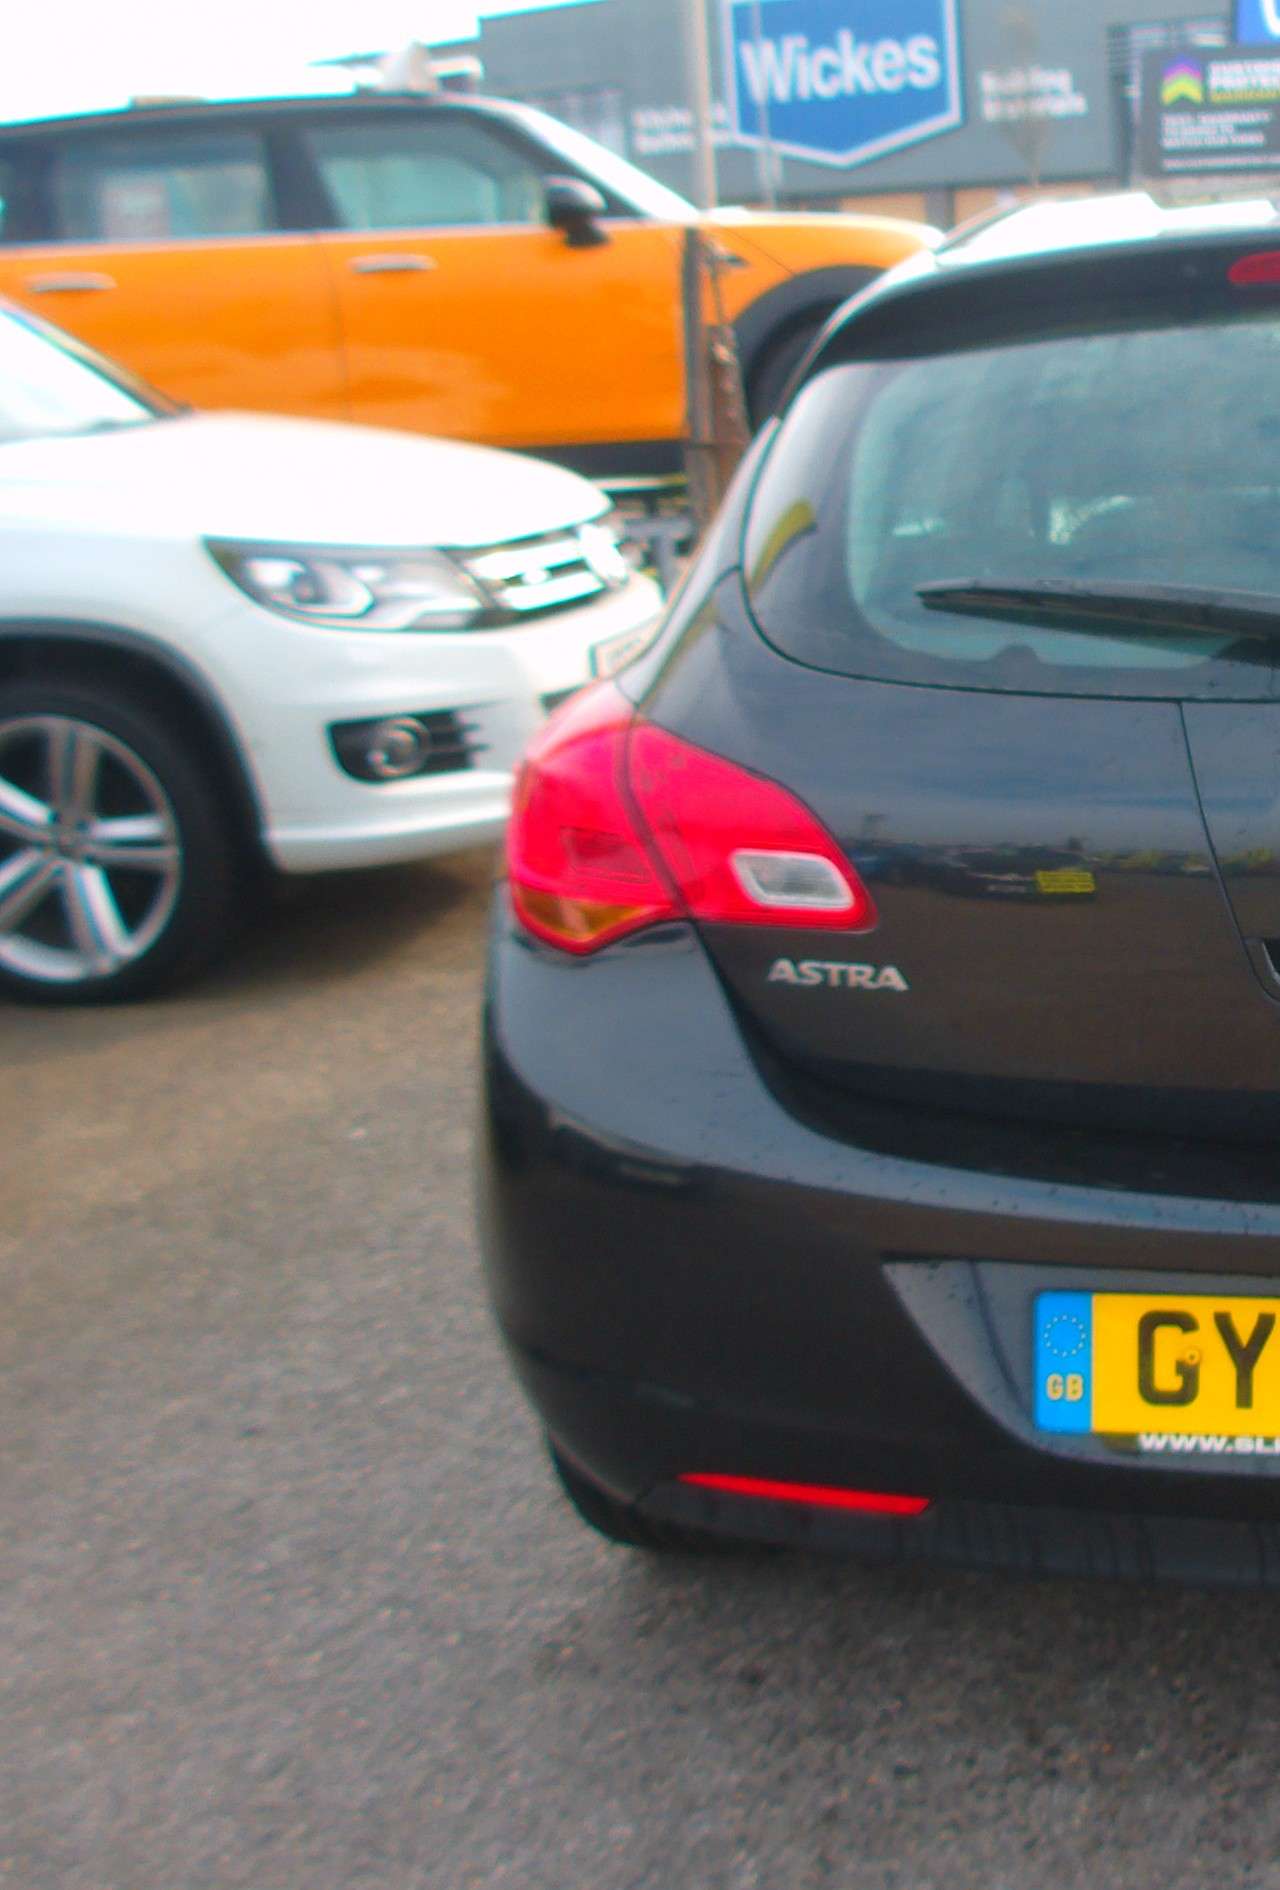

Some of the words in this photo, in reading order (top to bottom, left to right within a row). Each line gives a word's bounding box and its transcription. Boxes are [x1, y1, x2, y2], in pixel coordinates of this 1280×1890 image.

[739, 28, 941, 103] Wickes
[767, 957, 909, 992] ASTRA
[1046, 1373, 1083, 1402] GB
